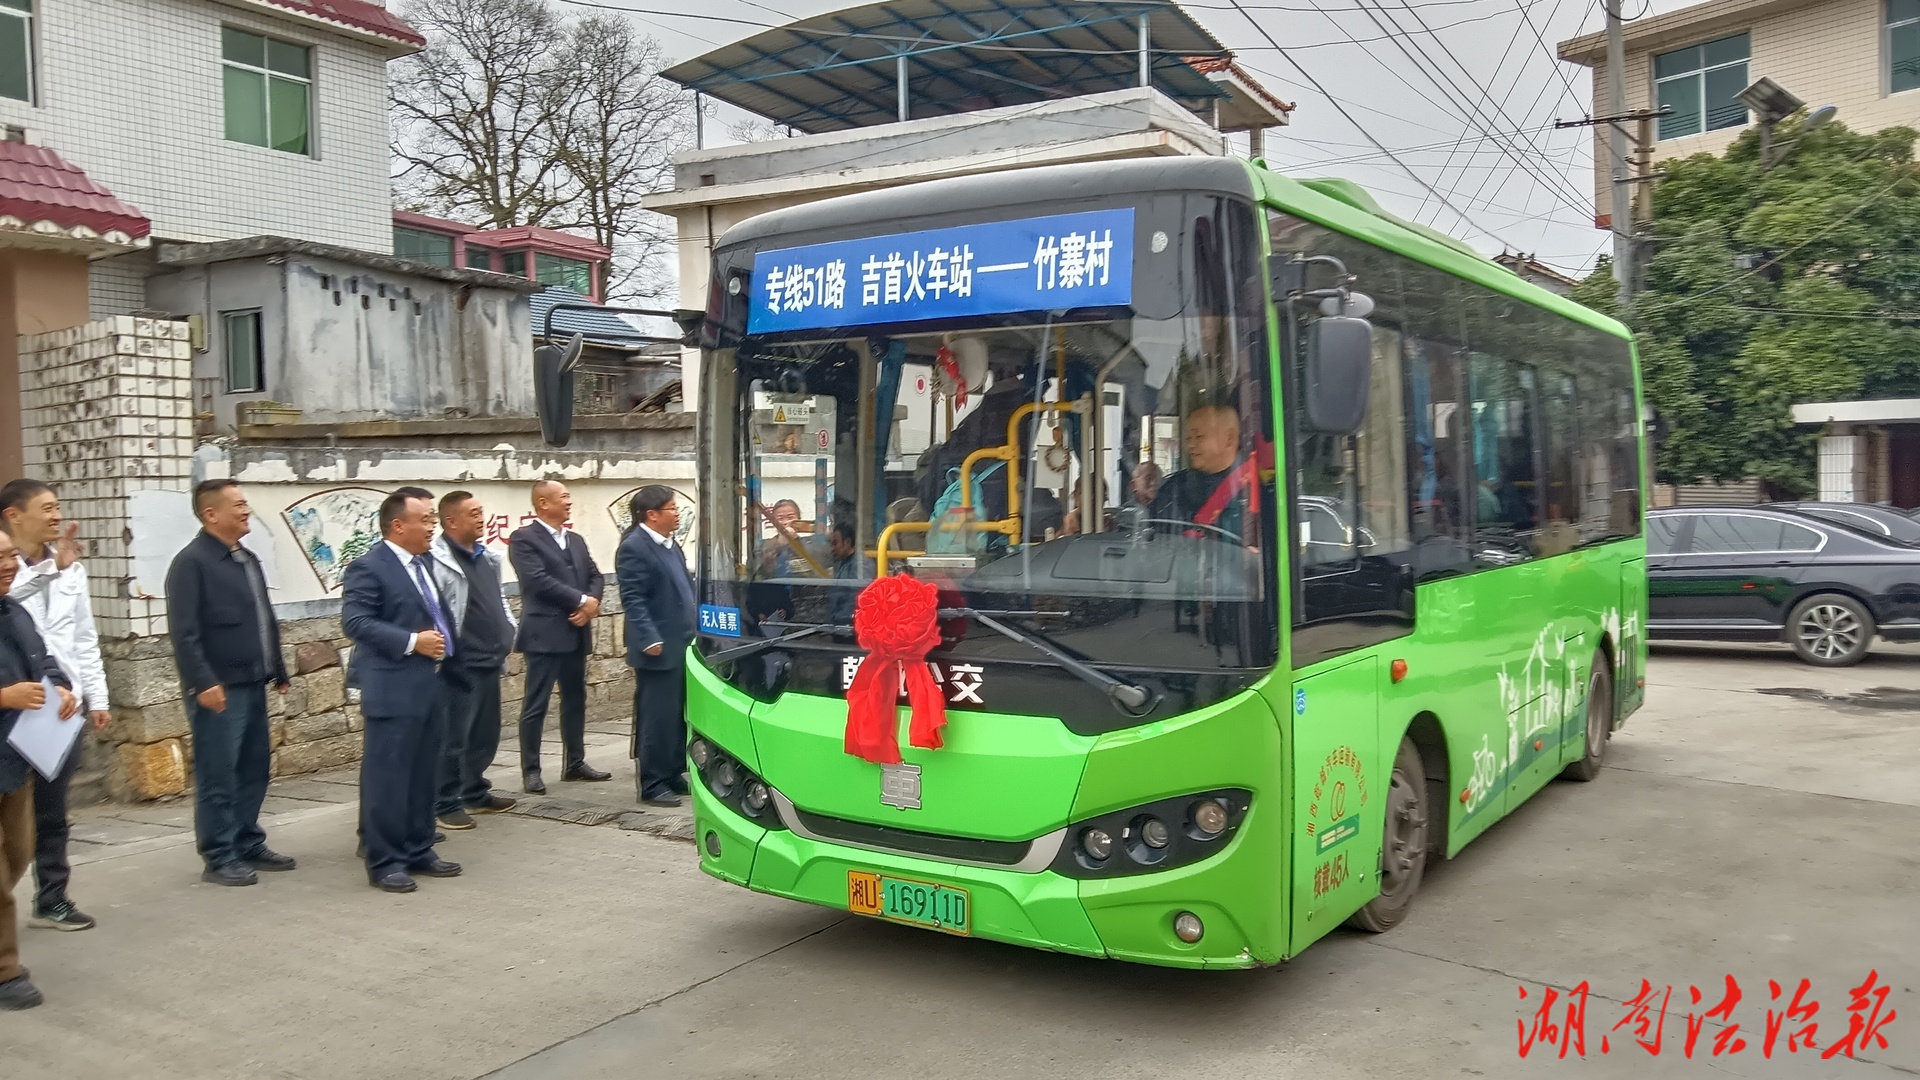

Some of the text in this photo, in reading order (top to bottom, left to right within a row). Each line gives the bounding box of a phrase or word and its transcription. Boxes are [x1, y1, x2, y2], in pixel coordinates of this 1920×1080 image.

[765, 258, 847, 315] 专线51路
[702, 610, 737, 631] 无人售票
